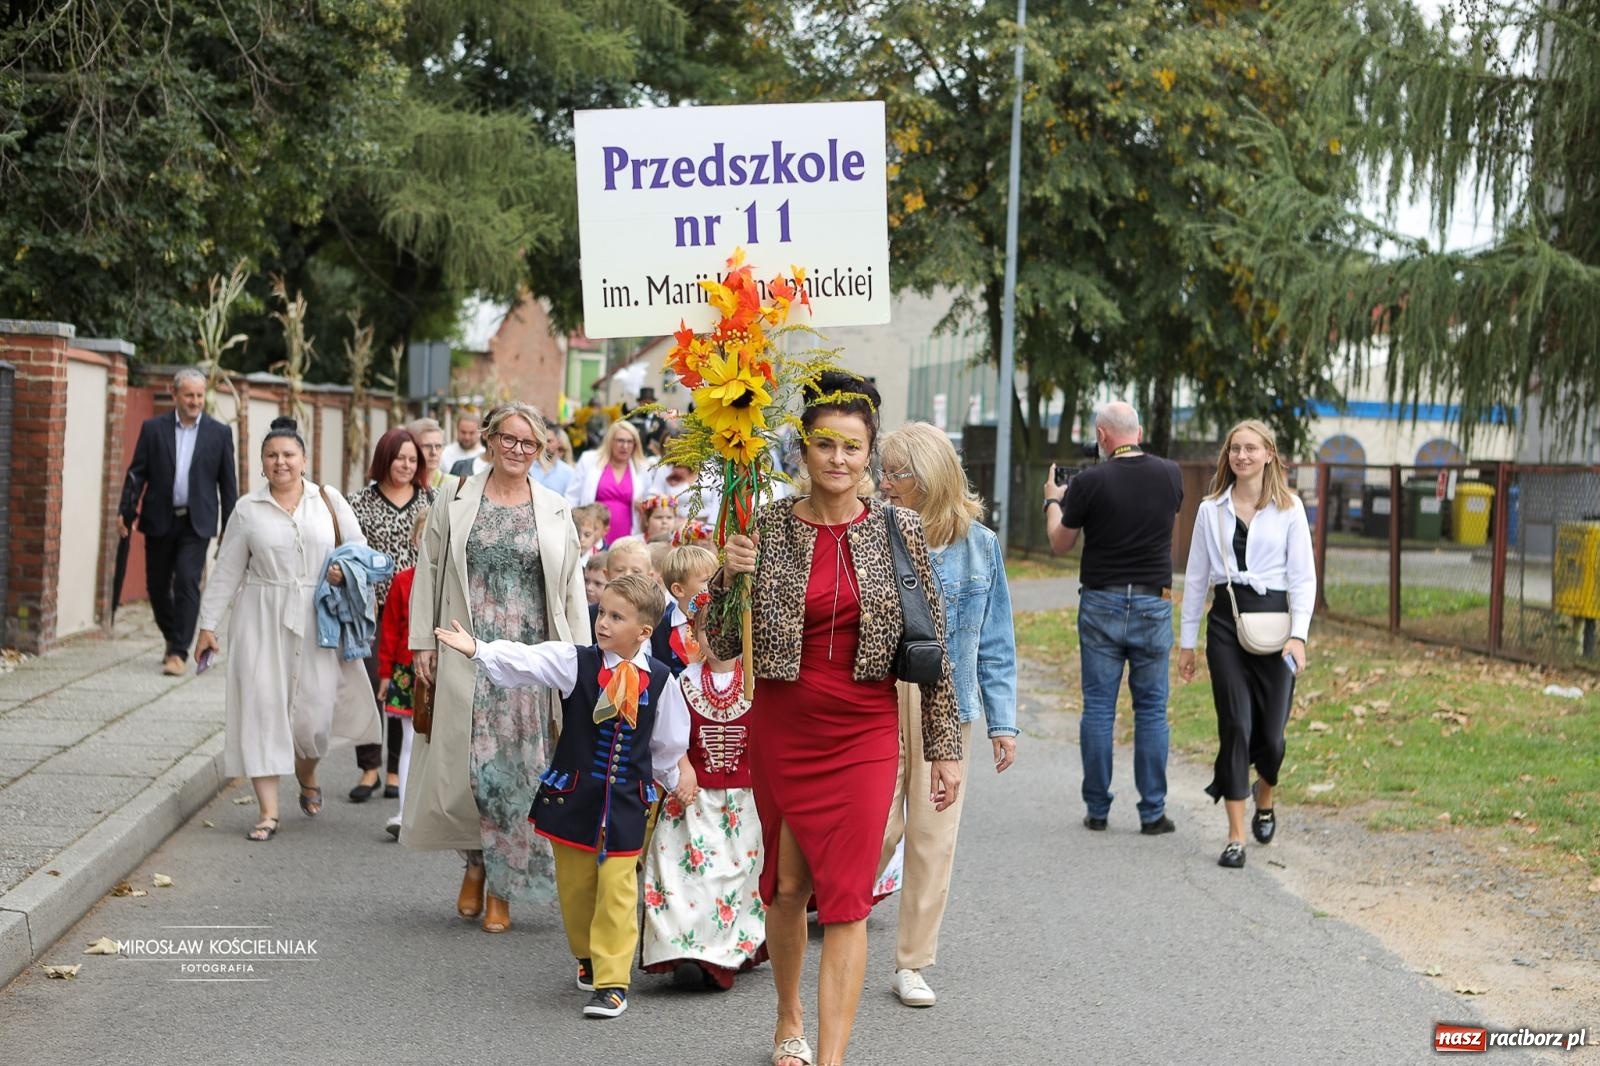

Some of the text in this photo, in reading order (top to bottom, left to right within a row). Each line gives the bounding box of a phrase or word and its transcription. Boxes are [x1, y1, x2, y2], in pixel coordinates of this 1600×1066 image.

[602, 138, 865, 191] Przedszkole
[674, 198, 792, 247] nr 11
[602, 266, 873, 308] im. Marii nnickiej
